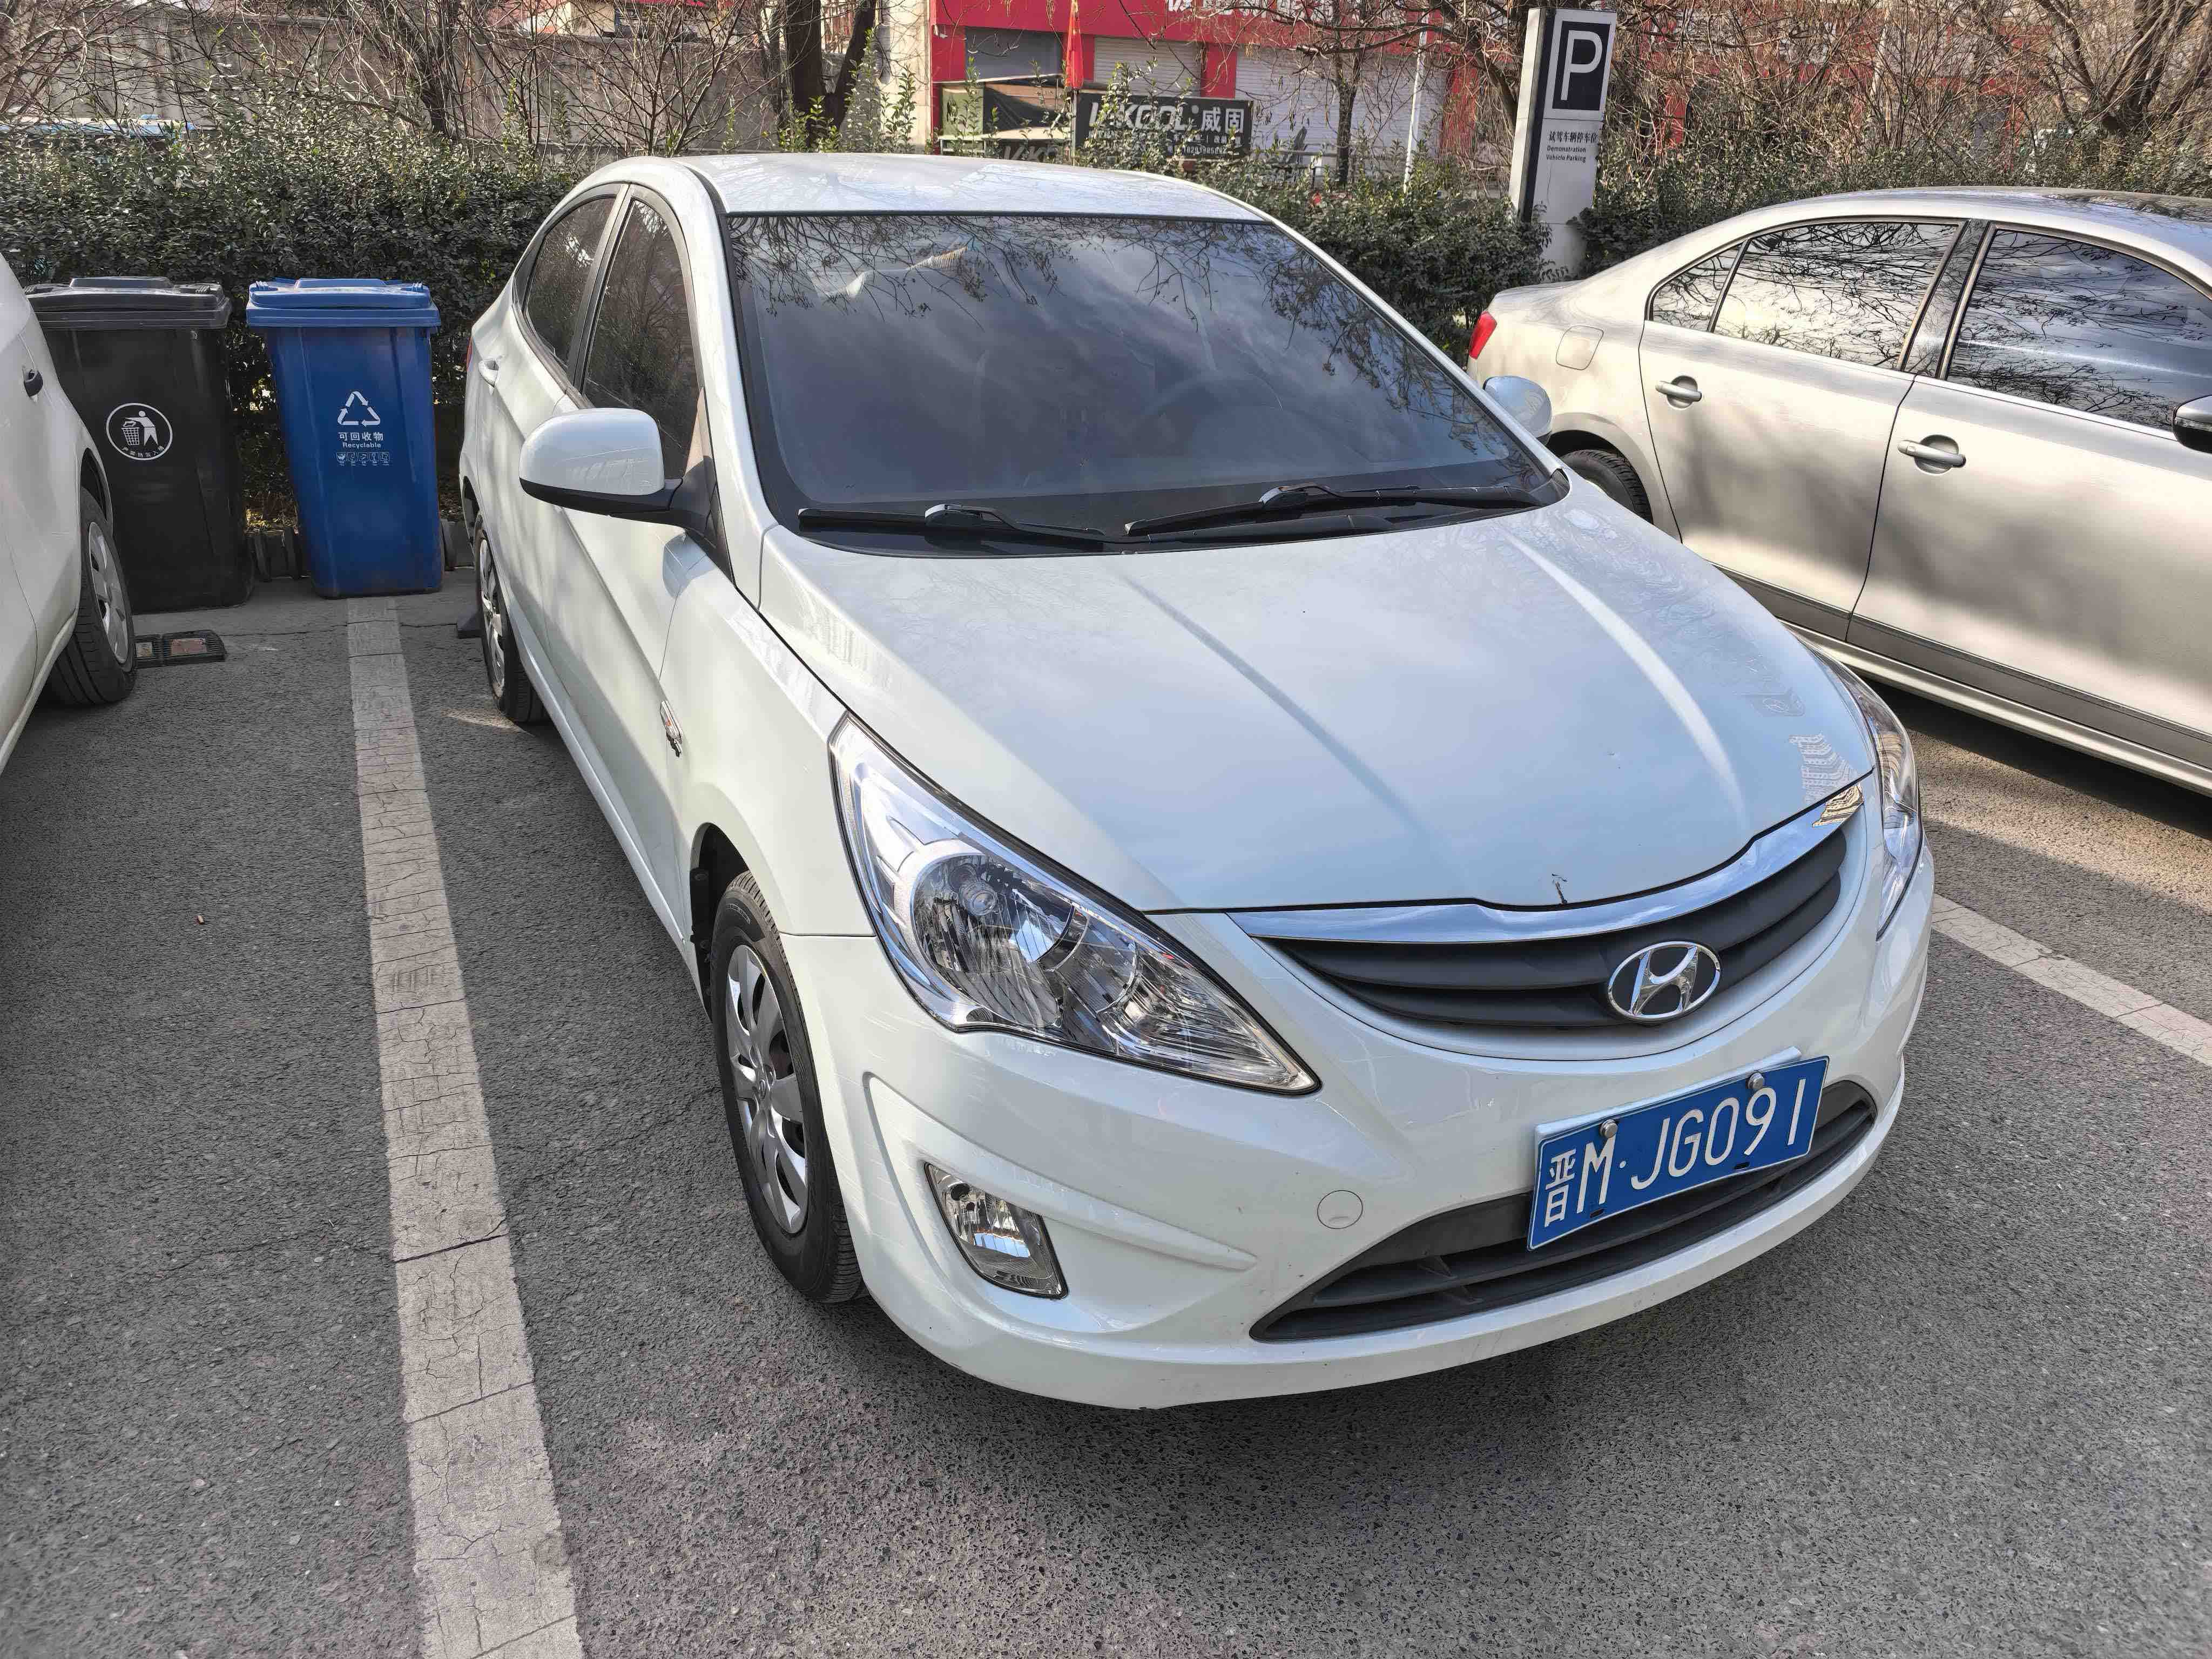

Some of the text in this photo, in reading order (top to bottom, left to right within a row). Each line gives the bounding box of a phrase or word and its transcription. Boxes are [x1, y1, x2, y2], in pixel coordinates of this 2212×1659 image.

[1561, 30, 1603, 101] P
[1201, 107, 1245, 133] 威固
[1547, 145, 1586, 153] Demonstration
[1566, 154, 1586, 163] Parking
[338, 431, 384, 441] 可回收物
